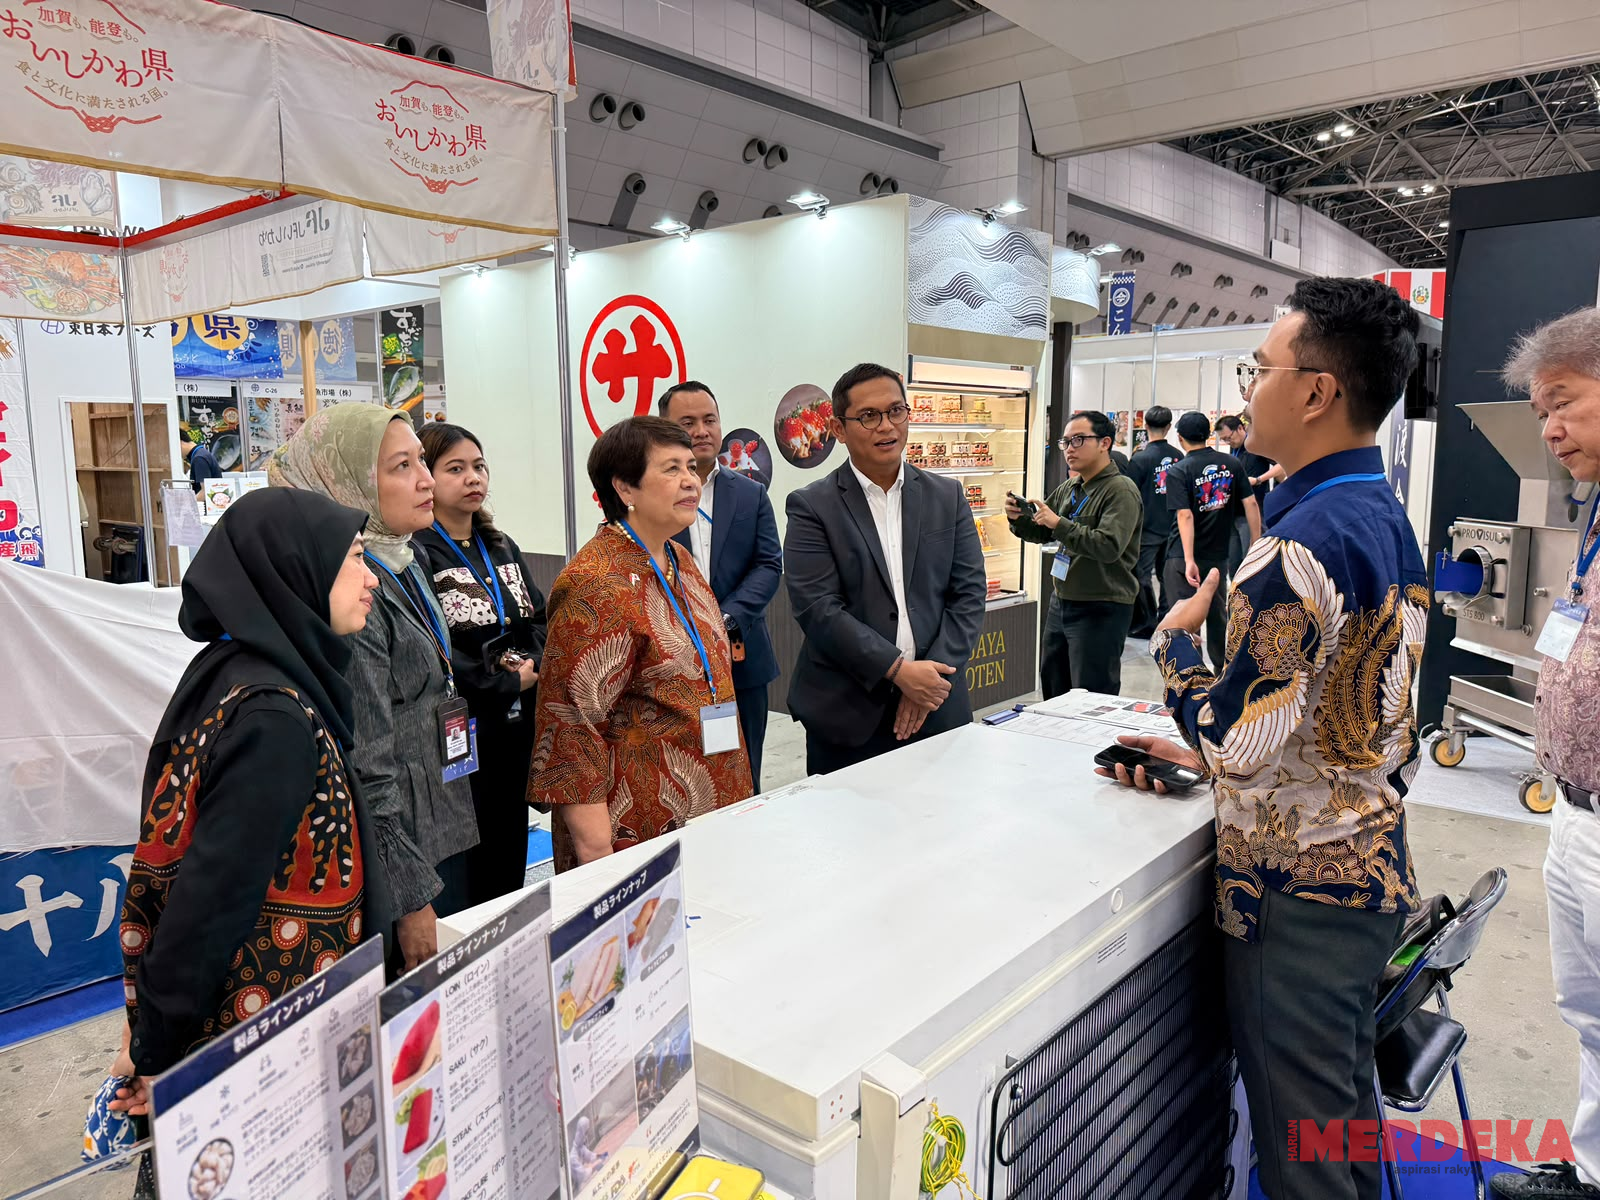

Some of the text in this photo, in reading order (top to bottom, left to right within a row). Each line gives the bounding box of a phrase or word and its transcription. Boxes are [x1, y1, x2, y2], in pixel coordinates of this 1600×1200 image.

[0, 9, 174, 88] おいしかわ県
[375, 98, 487, 156] おいしかわ県
[68, 321, 156, 339] 東日本フズ
[1462, 528, 1498, 541] PROVISU
[593, 869, 648, 920] 製品ラインナップ
[437, 916, 508, 976] 製品ラインナップ
[232, 978, 327, 1054] 製品ラインナップ
